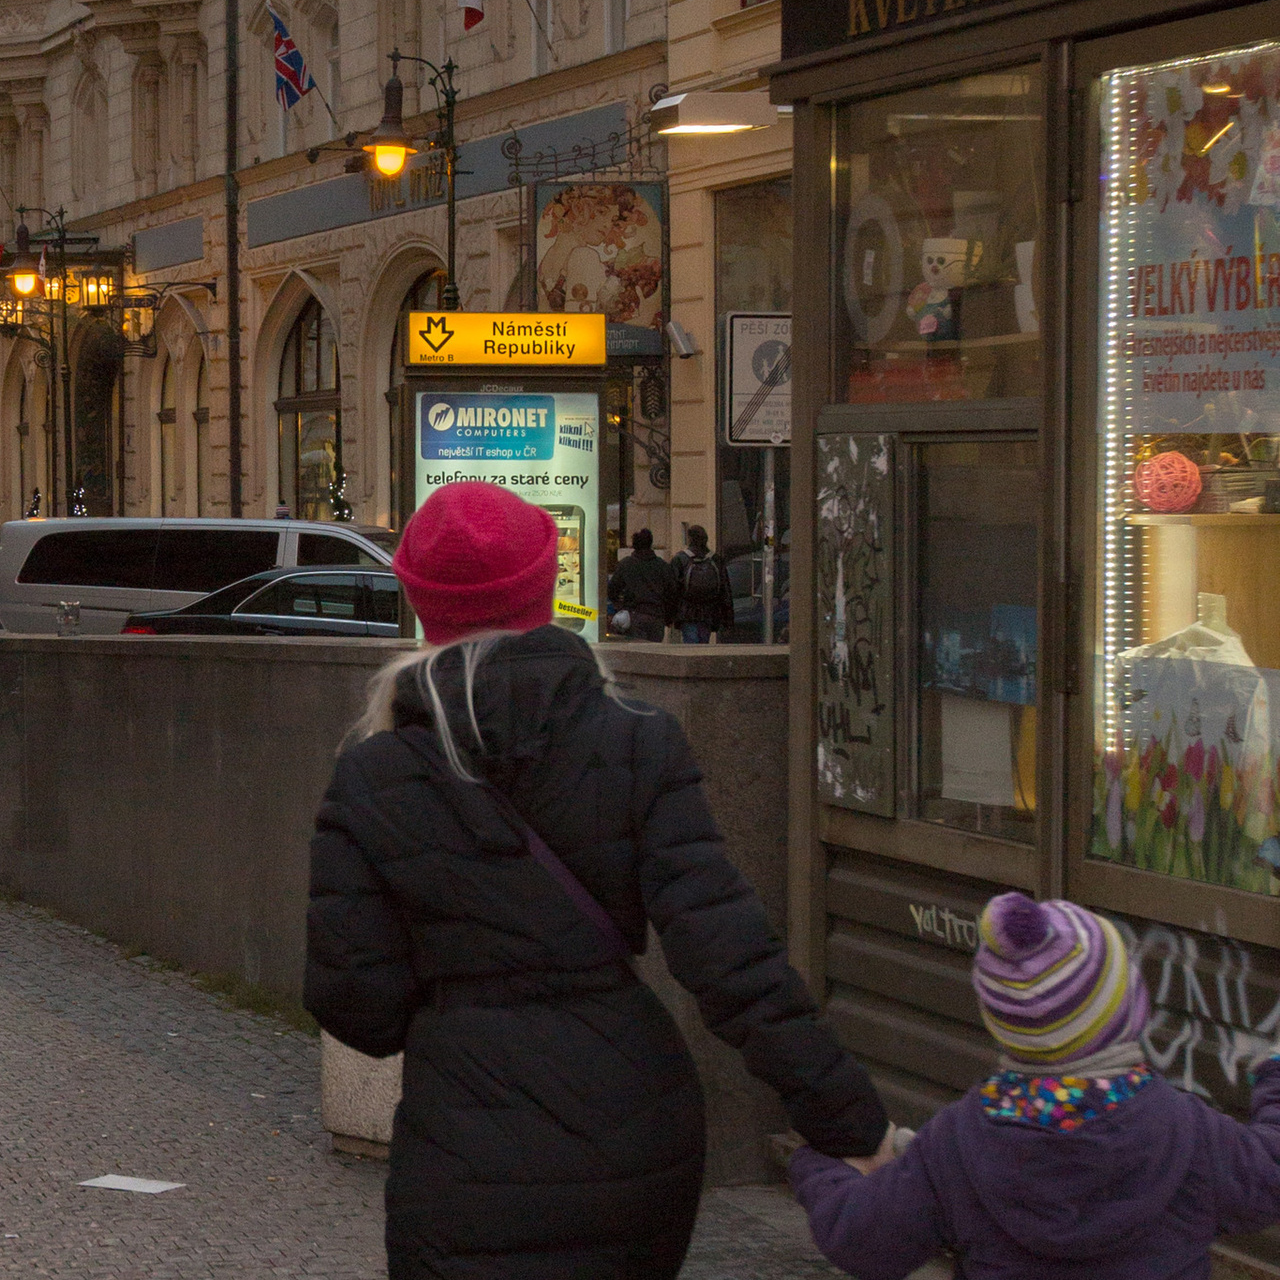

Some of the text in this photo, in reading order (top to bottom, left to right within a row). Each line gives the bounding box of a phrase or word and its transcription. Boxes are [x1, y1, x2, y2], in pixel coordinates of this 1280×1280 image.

[1128, 249, 1198, 317] VELKÝ
[492, 321, 568, 337] Náměstí
[773, 319, 791, 334] ZÓ
[483, 339, 576, 359] Republiky
[420, 354, 455, 362] Metro B
[480, 384, 524, 393] JCDecaux
[456, 407, 548, 428] MIRONET
[456, 428, 527, 437] COMPUTERS
[559, 424, 583, 436] klikni
[438, 445, 537, 459] největší IT eshop v ČR
[490, 473, 506, 485] za
[510, 471, 550, 486] staré
[554, 474, 589, 489] ceny
[558, 602, 593, 617] bestseller
